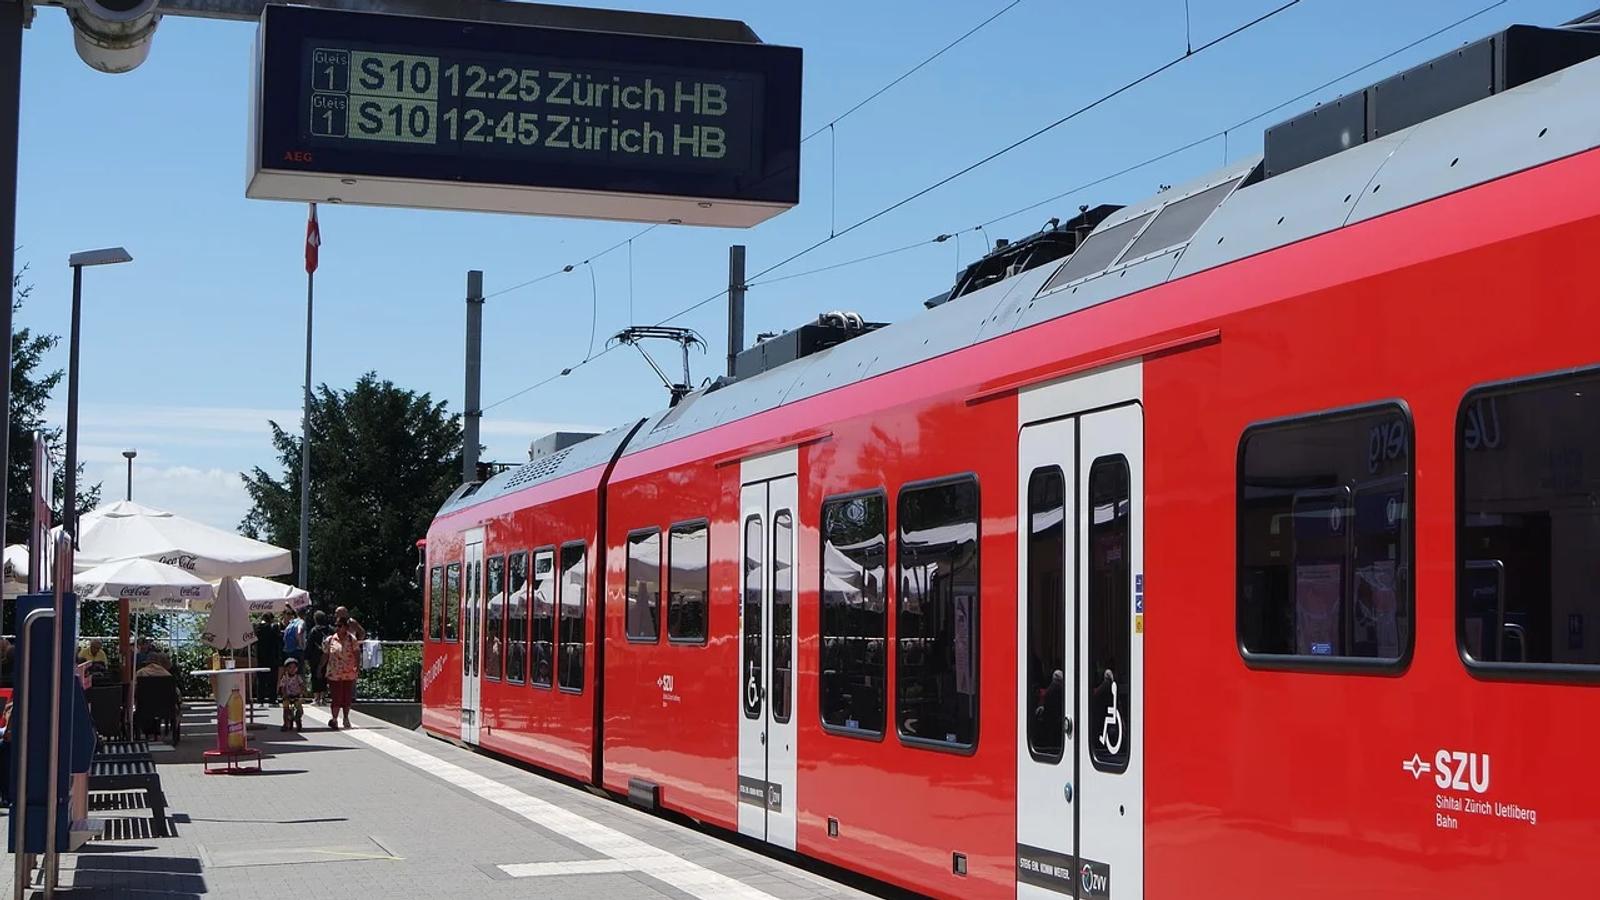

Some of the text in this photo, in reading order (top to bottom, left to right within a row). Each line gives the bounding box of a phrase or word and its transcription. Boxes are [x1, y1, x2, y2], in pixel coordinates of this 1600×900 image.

[315, 52, 347, 65] Gleis
[323, 66, 334, 90] 1
[358, 57, 728, 116] S10 12:25 Zürich HB
[313, 96, 346, 110] Gleis
[322, 110, 333, 134] 1
[357, 101, 726, 158] S10 12:45 Zürich HB
[284, 151, 313, 162] AEG
[1435, 749, 1489, 793] SZU
[1436, 794, 1536, 825] Sihltal Zürich Uetliberg
[1436, 813, 1458, 829] Bahn
[1093, 874, 1106, 891] ZVV
